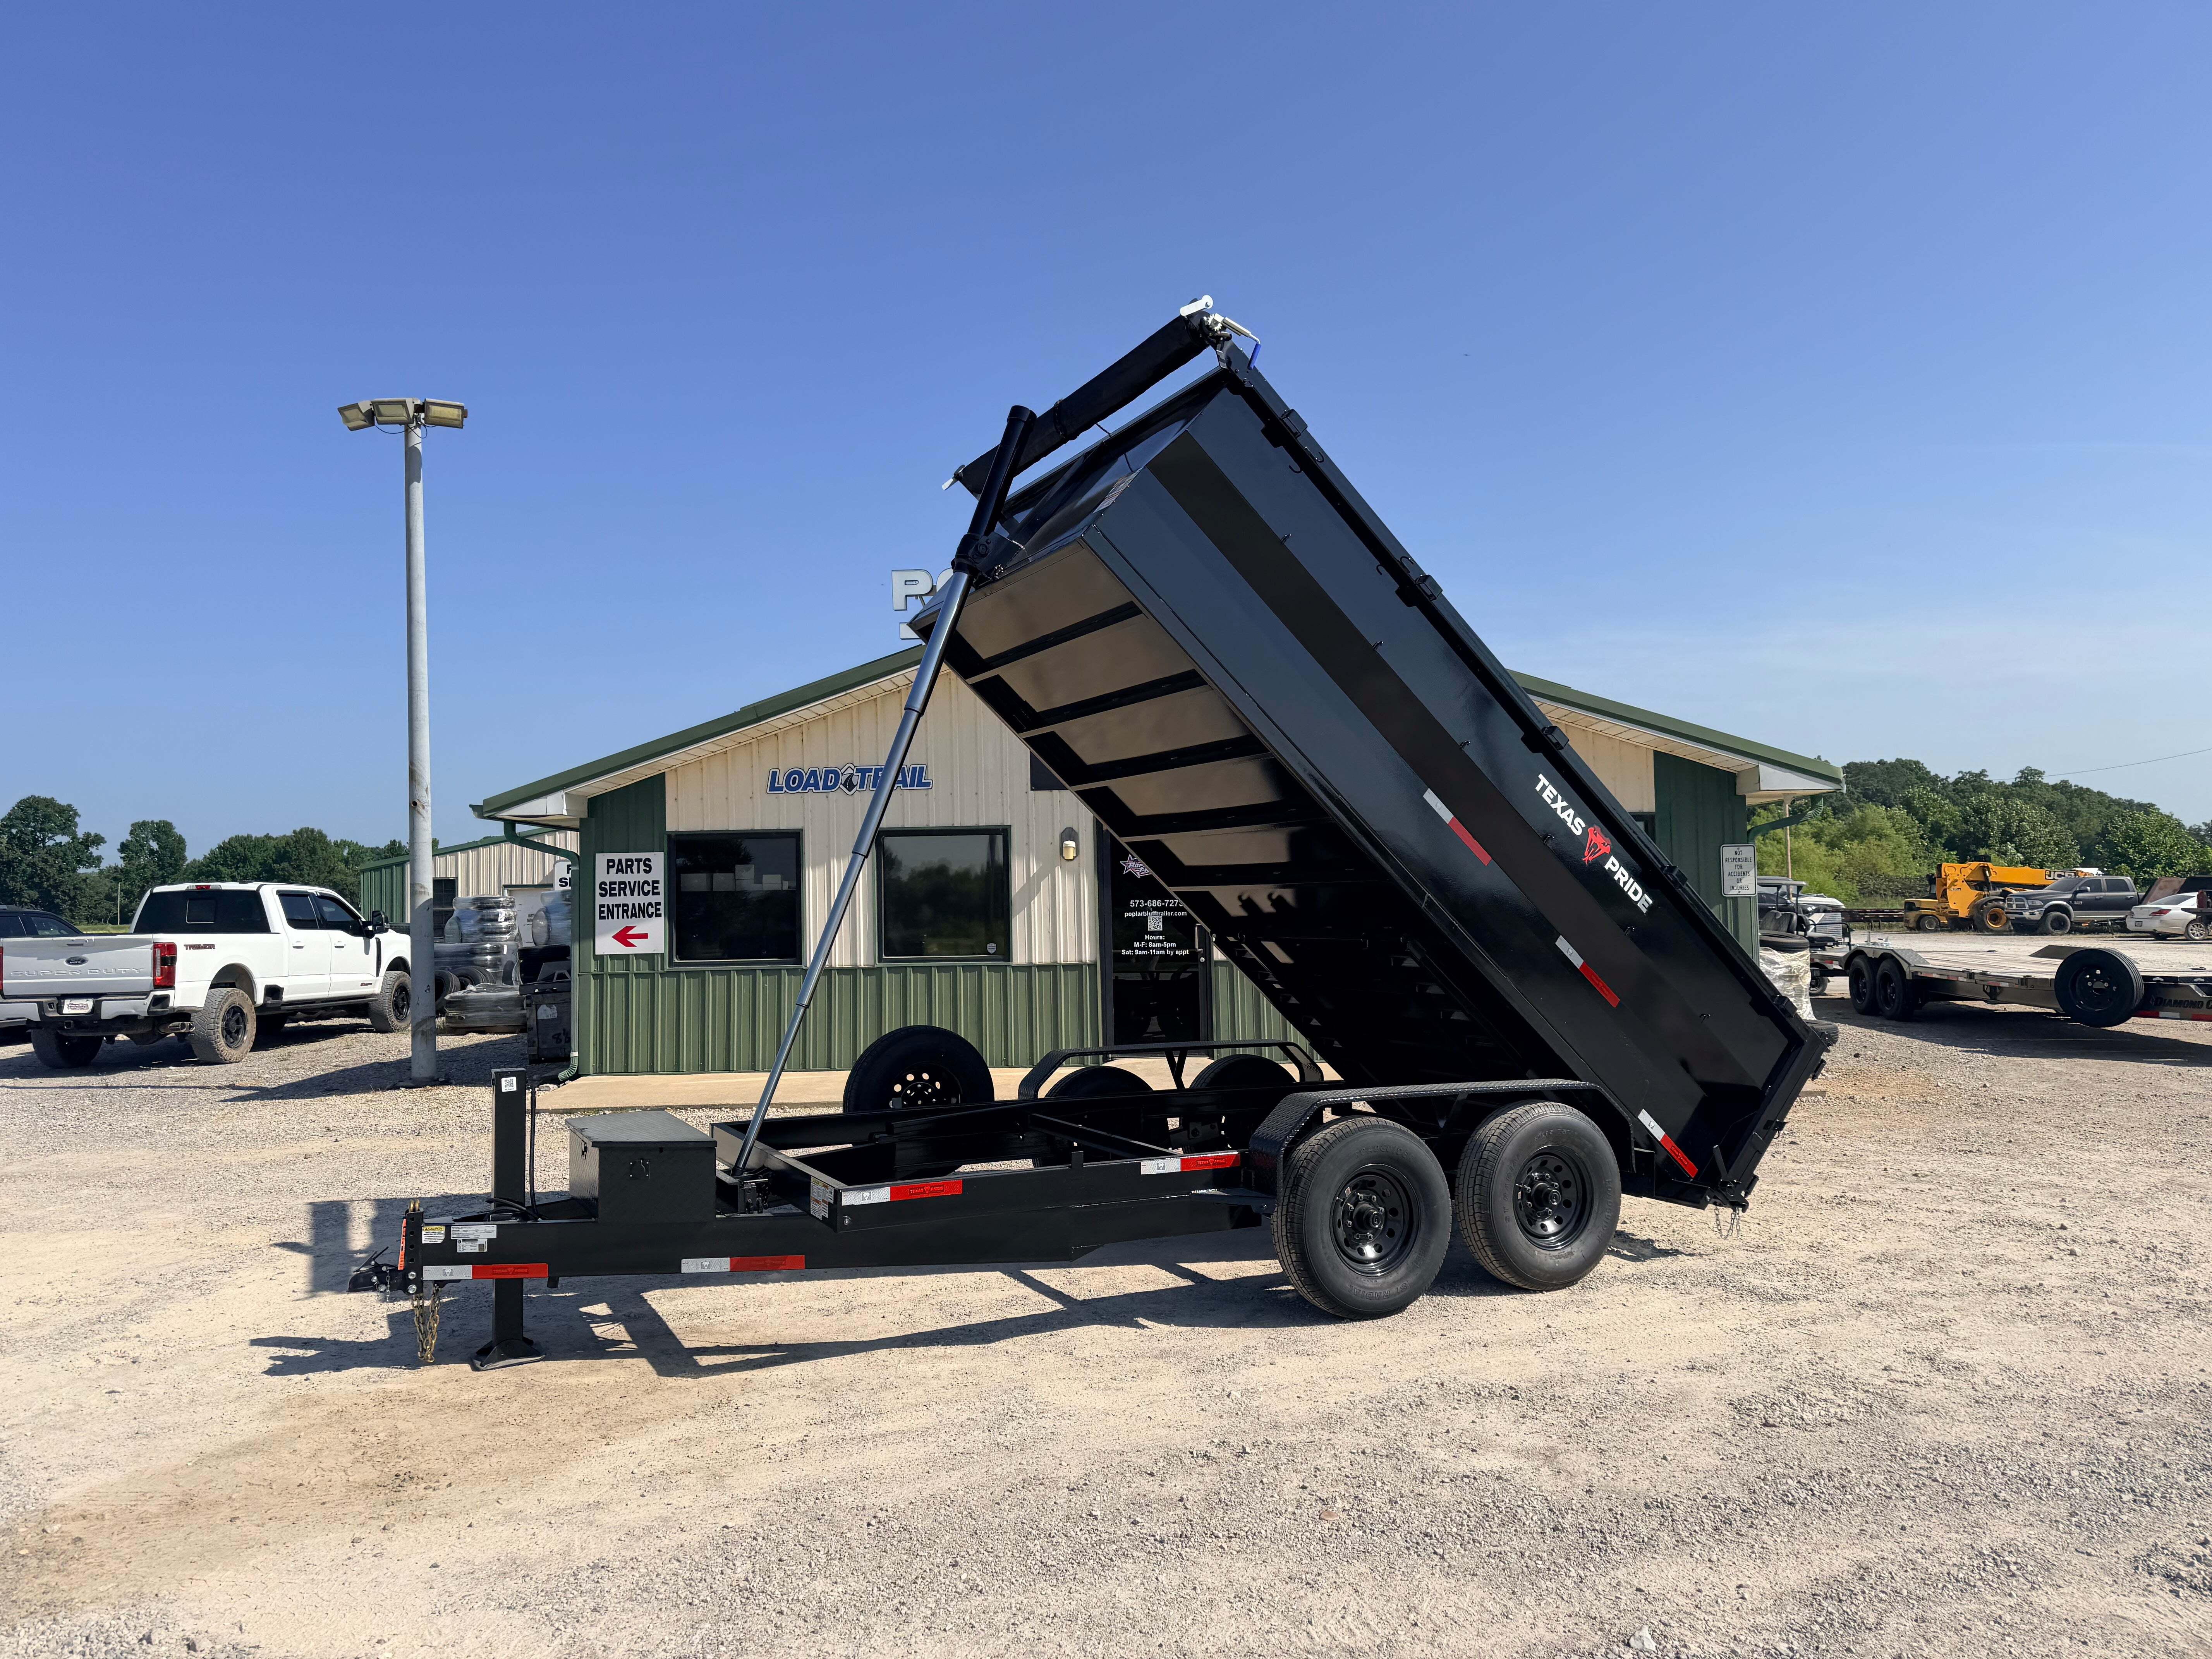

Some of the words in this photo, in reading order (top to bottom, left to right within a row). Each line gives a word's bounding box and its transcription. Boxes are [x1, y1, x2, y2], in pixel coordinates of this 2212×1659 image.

[768, 769, 841, 793] LOAD
[1535, 773, 1586, 836] TEXAS
[1604, 855, 1652, 913] PRIDE
[606, 858, 652, 874] PARTS
[2045, 871, 2075, 880] JCB
[599, 880, 660, 897] SERVICE
[599, 902, 662, 920] ENTRANCE
[2154, 997, 2203, 1009] DIAMOND
